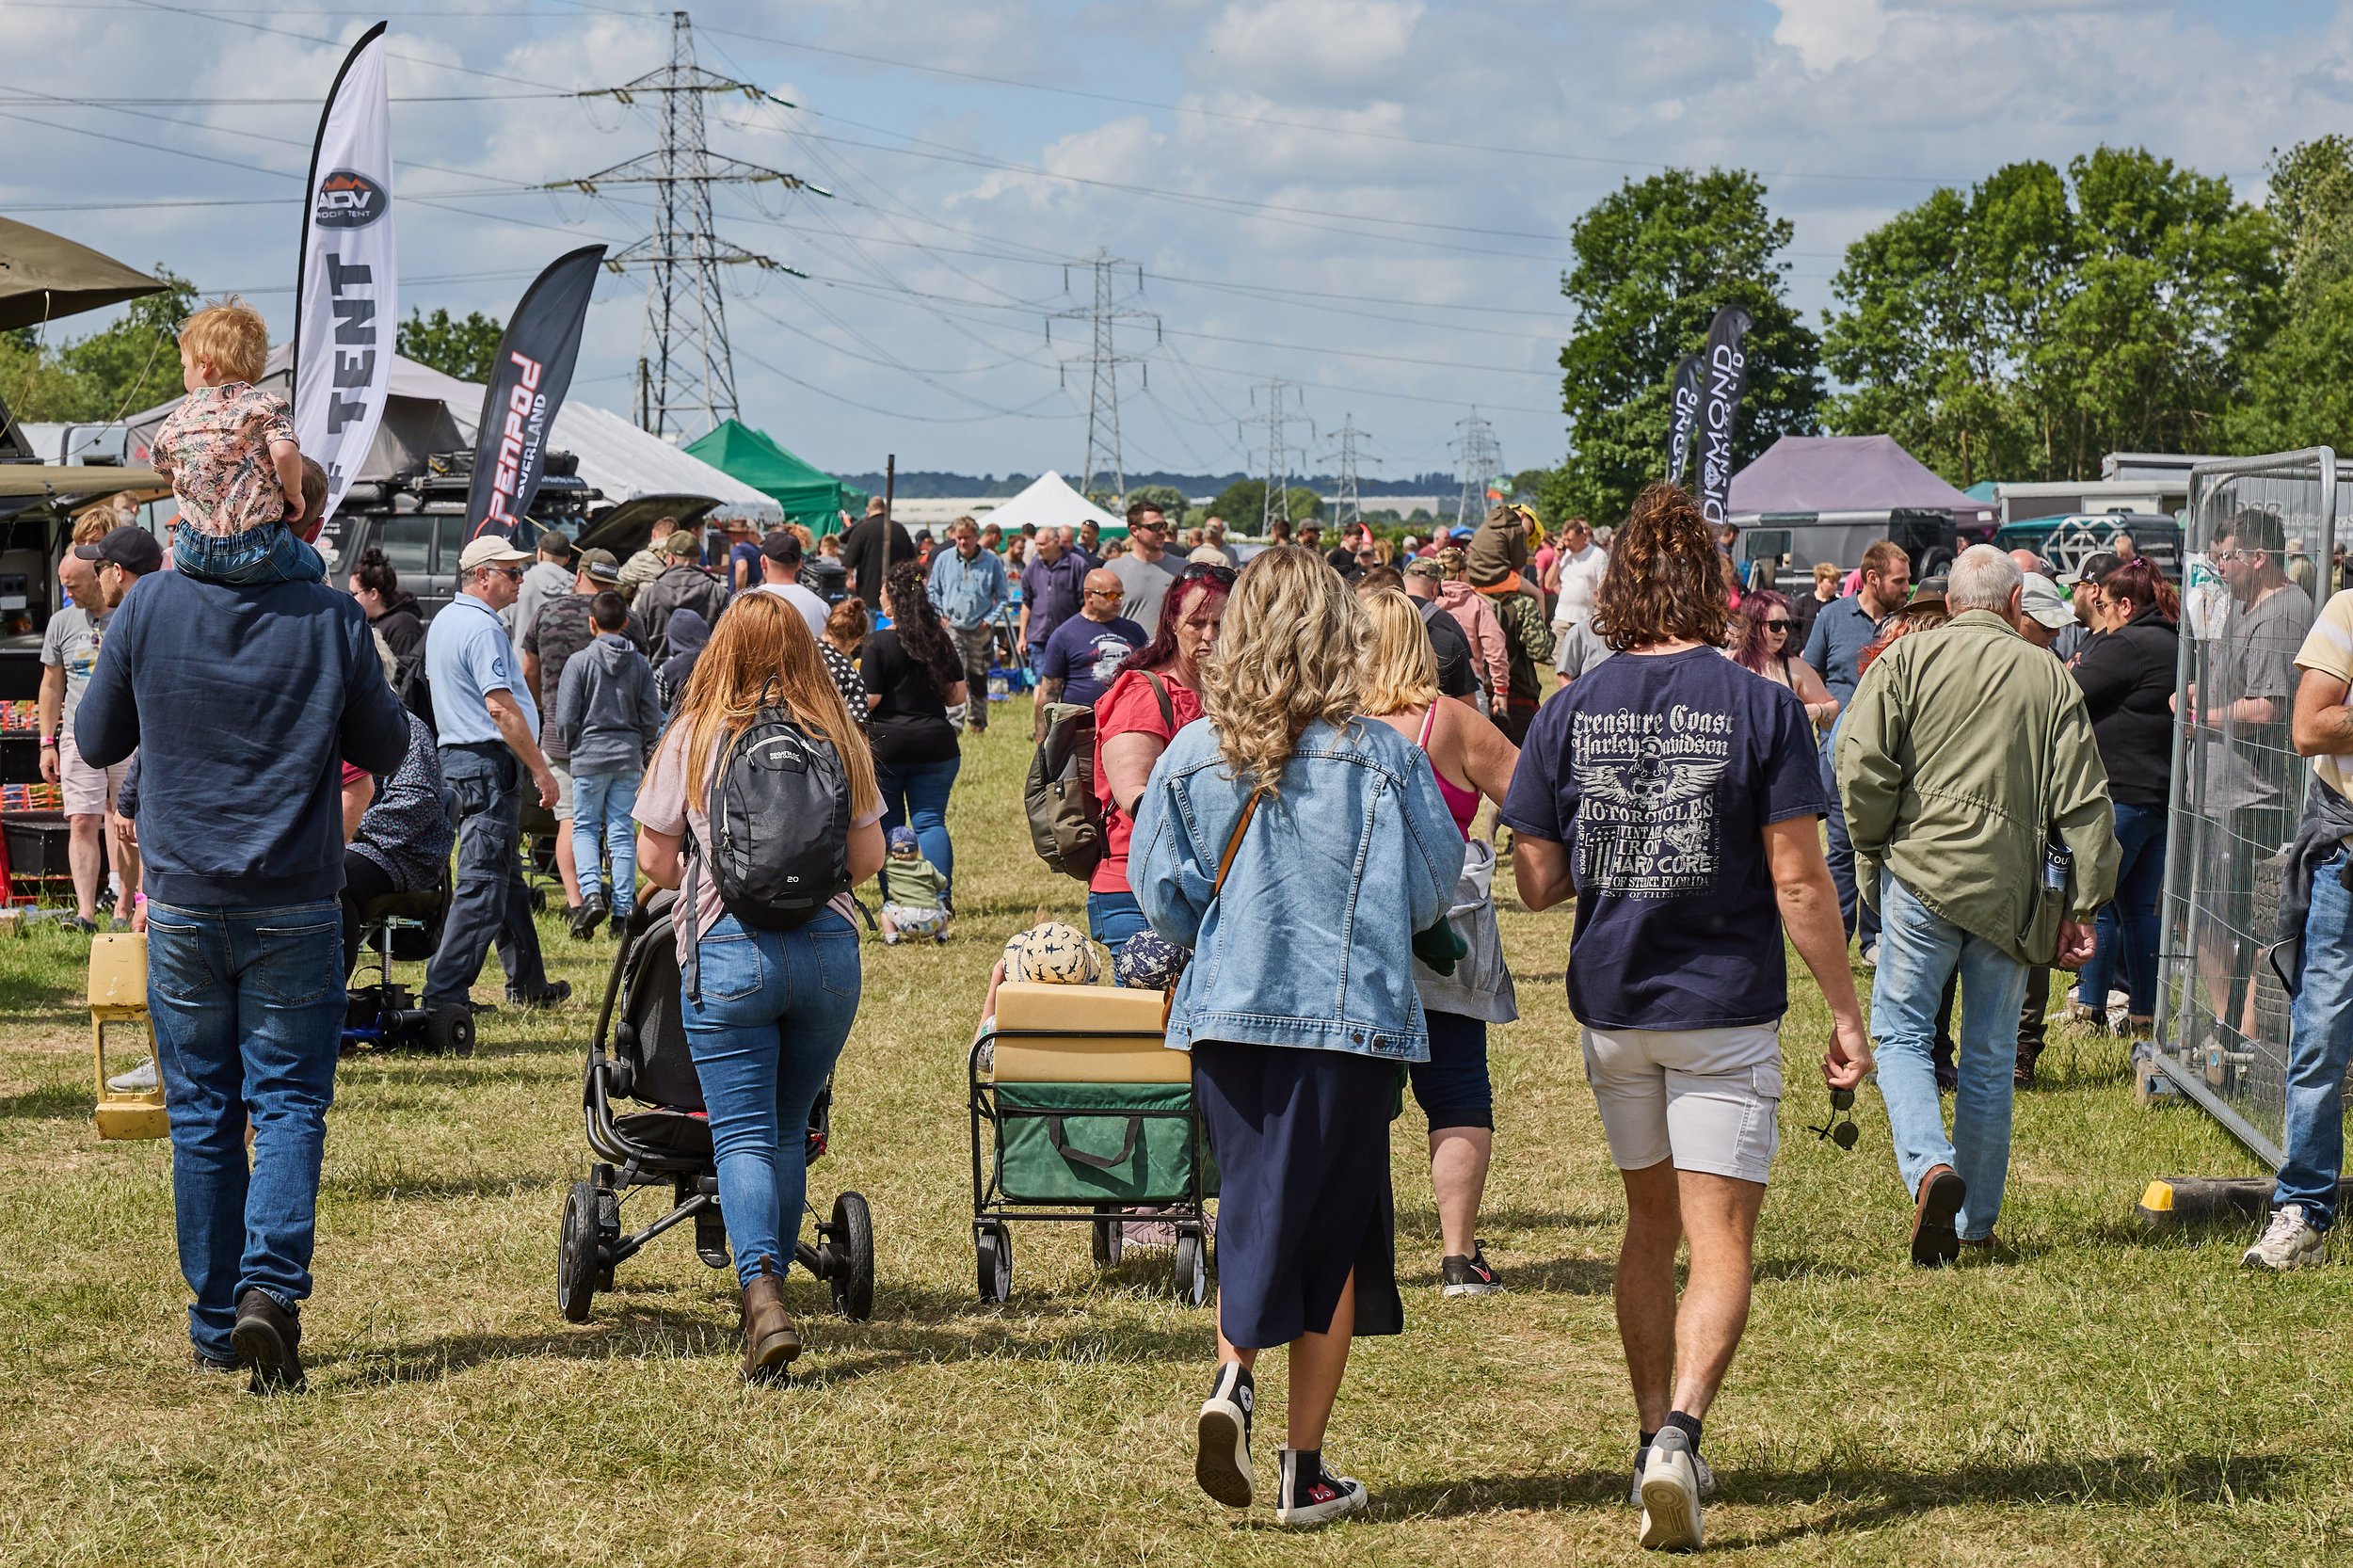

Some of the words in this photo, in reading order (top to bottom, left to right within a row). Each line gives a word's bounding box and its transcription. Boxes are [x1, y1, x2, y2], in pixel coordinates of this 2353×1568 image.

[326, 252, 376, 435] TENT
[517, 393, 547, 501] OVERLAND
[1670, 704, 1735, 735] Coast
[1617, 840, 1663, 856] IRON
[1612, 855, 1654, 875] HARD
[1657, 855, 1714, 874] CORE
[1612, 876, 1627, 888] OF
